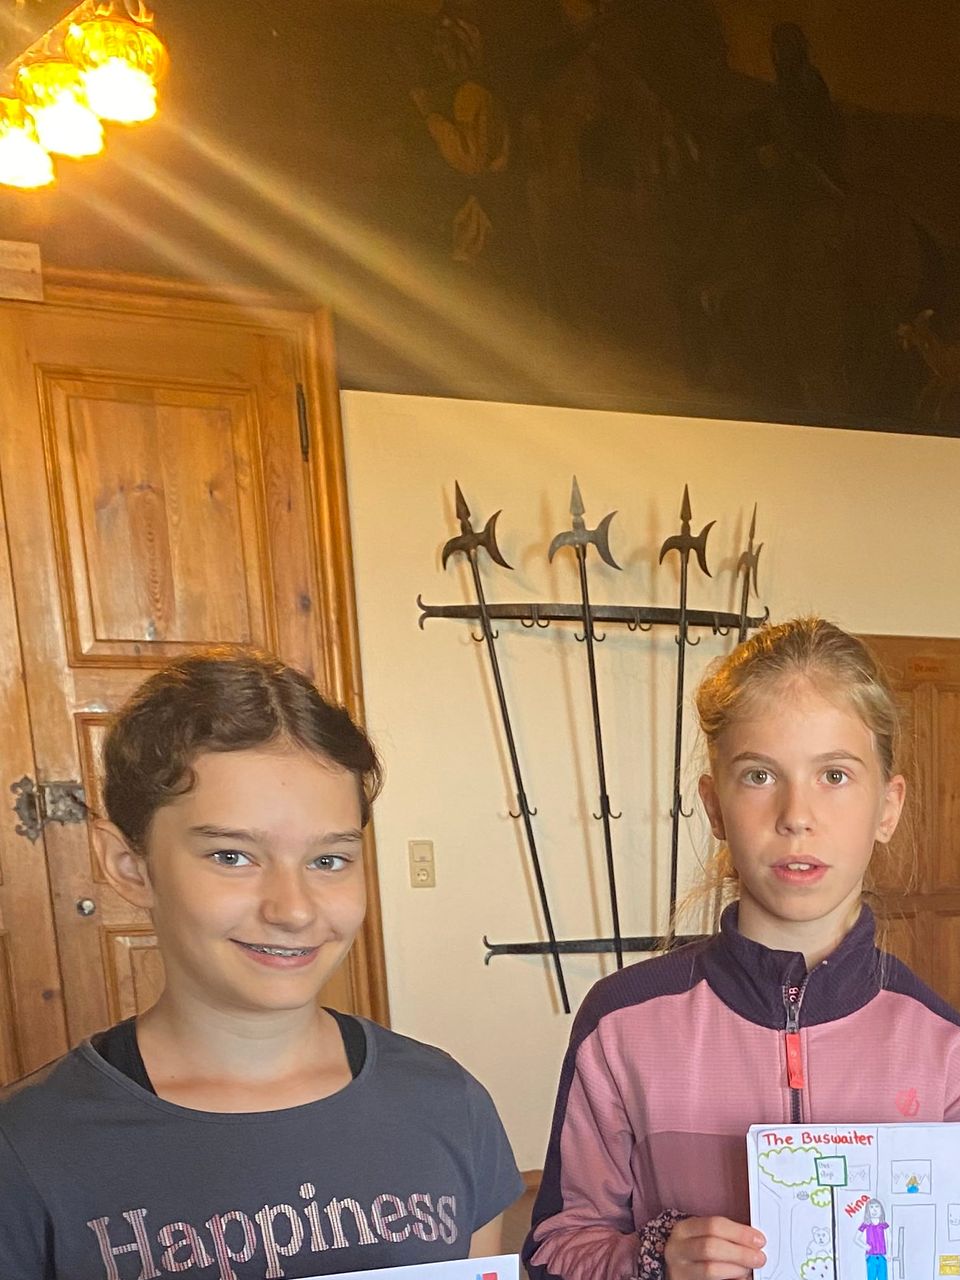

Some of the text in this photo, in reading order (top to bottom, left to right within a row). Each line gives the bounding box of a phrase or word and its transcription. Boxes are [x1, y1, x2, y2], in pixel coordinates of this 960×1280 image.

[762, 1131, 874, 1146] The Buswaiter
[844, 1193, 871, 1218] Nina
